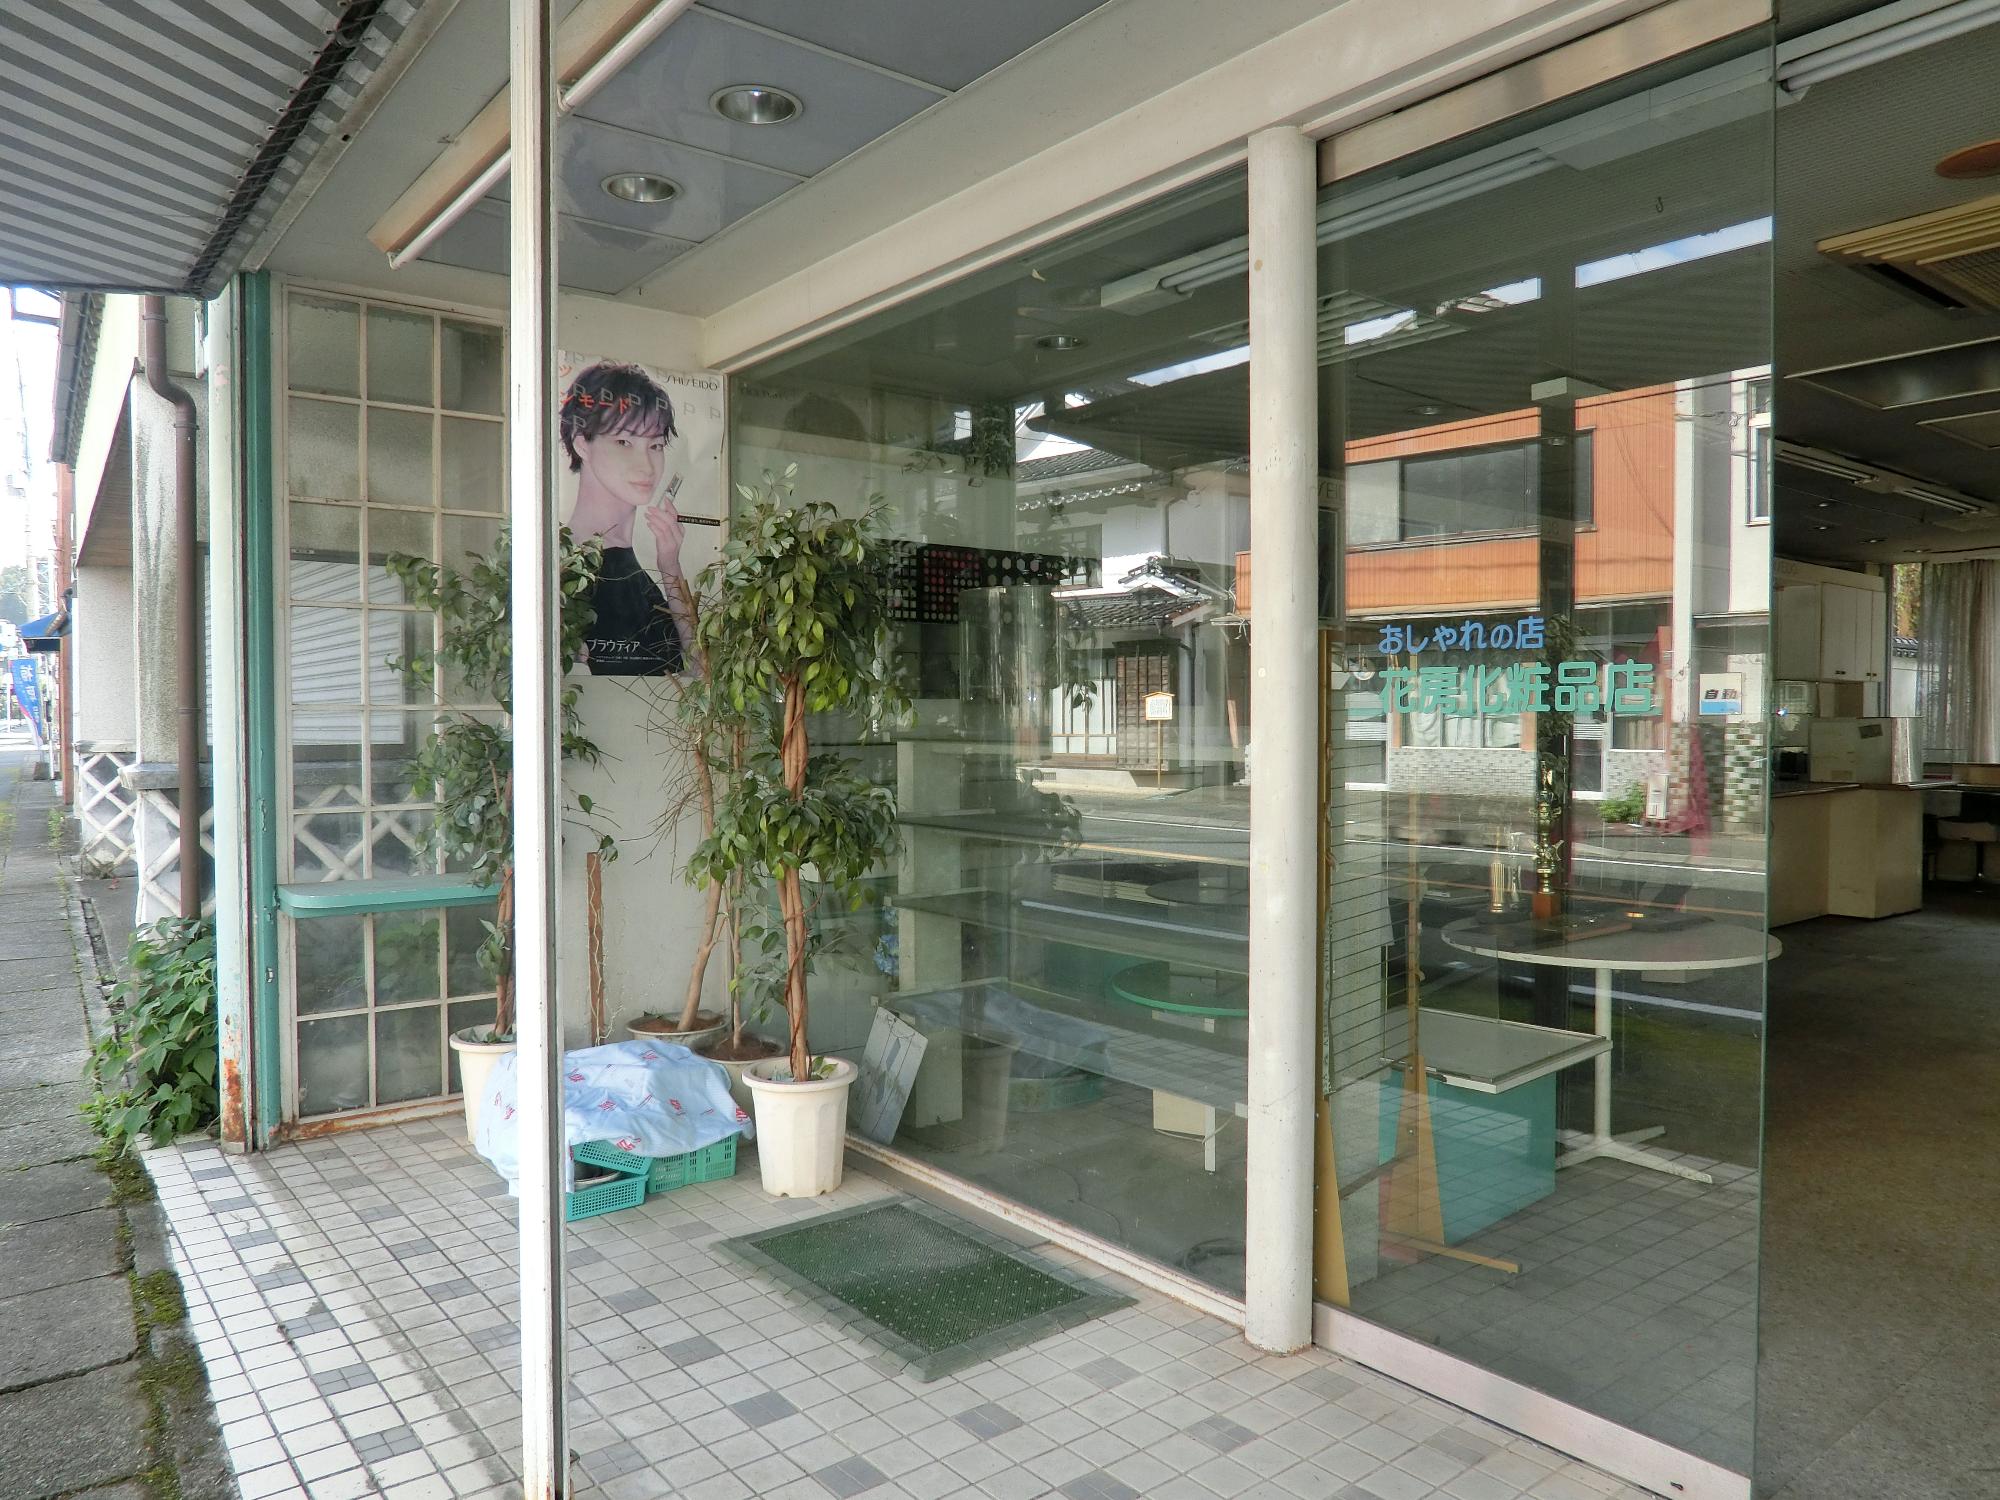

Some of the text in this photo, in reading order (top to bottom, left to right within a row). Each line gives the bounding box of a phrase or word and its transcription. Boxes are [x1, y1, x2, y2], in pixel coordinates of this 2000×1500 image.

[664, 374, 718, 392] SHISEIDO
[1378, 616, 1545, 655] おしゃれの店
[1378, 658, 1654, 714] 花房化粧品店
